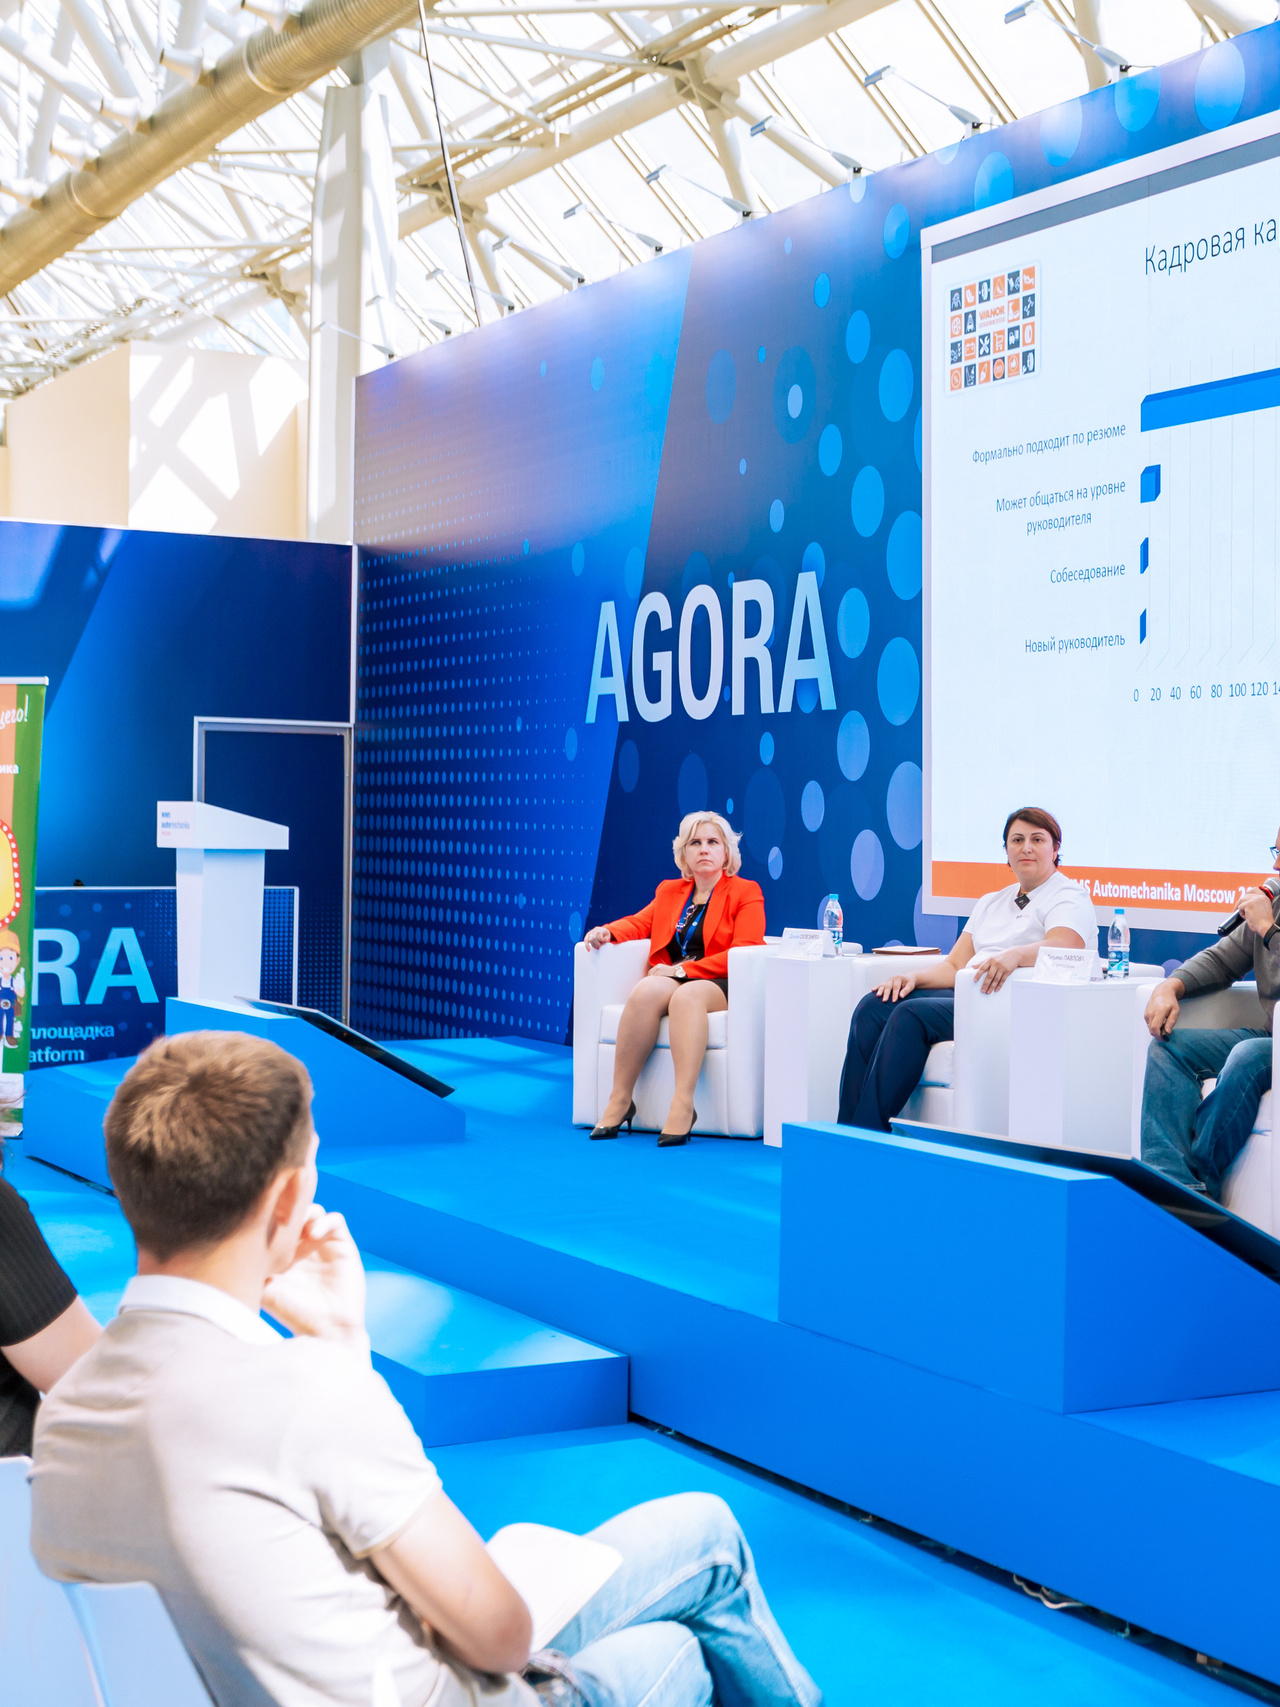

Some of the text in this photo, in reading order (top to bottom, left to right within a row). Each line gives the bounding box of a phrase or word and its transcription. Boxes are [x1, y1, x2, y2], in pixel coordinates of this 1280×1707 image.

[1145, 227, 1245, 275] Кадровая
[972, 424, 1126, 465] Формально подходит по резюме
[996, 481, 1126, 512] Может общаться на уровне
[1026, 512, 1092, 536] руководителя
[1050, 564, 1126, 583] Собеседование
[585, 571, 837, 724] AGORA
[1025, 633, 1126, 654] Новый руководитель
[1133, 689, 1139, 702] 0
[1150, 688, 1162, 701] 20
[1170, 686, 1181, 700] 40
[1190, 685, 1202, 699] 60
[1211, 684, 1222, 698] 80
[1229, 683, 1247, 697] 100
[1251, 682, 1269, 696] 120
[1093, 880, 1181, 901] Automechanika
[1184, 883, 1235, 904] Moscow
